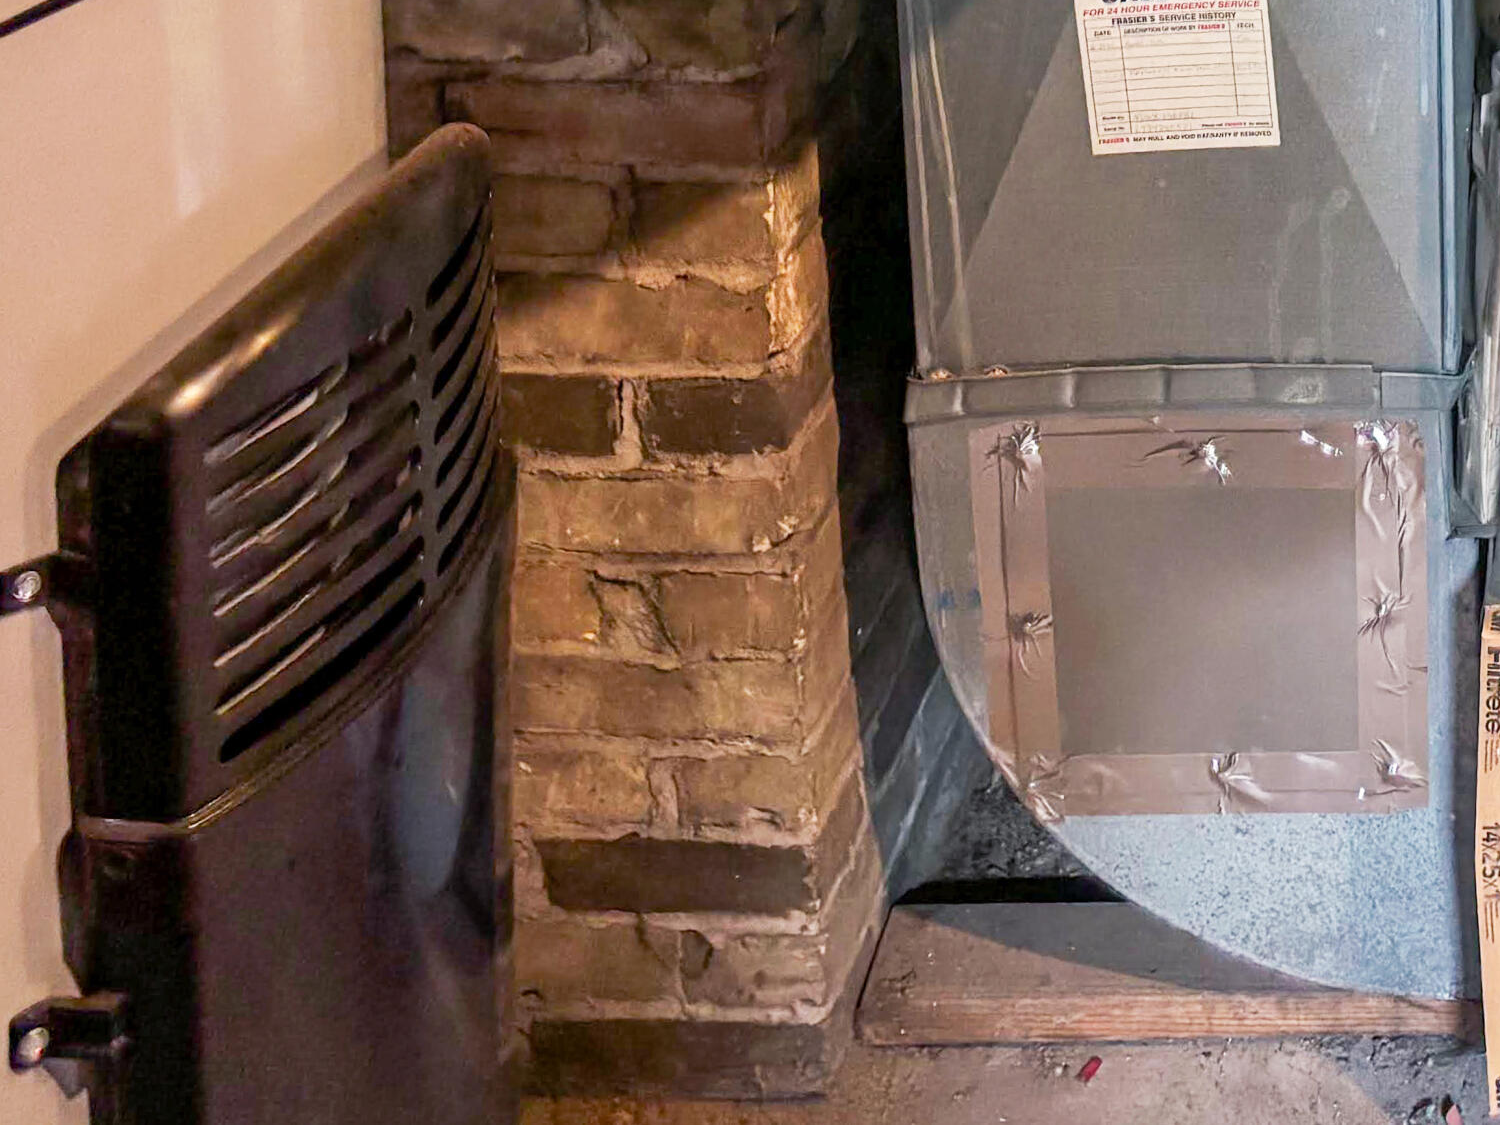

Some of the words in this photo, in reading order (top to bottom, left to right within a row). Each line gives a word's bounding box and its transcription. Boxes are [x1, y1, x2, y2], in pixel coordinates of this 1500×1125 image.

[1083, 9, 1106, 17] FOR
[1106, 7, 1119, 15] 24
[1121, 5, 1150, 14] HOUR
[1152, 2, 1215, 12] EMERGENCY
[1217, 0, 1260, 9] SERVICE
[1158, 13, 1197, 22] SERVICE
[1199, 11, 1237, 20] HISTORY
